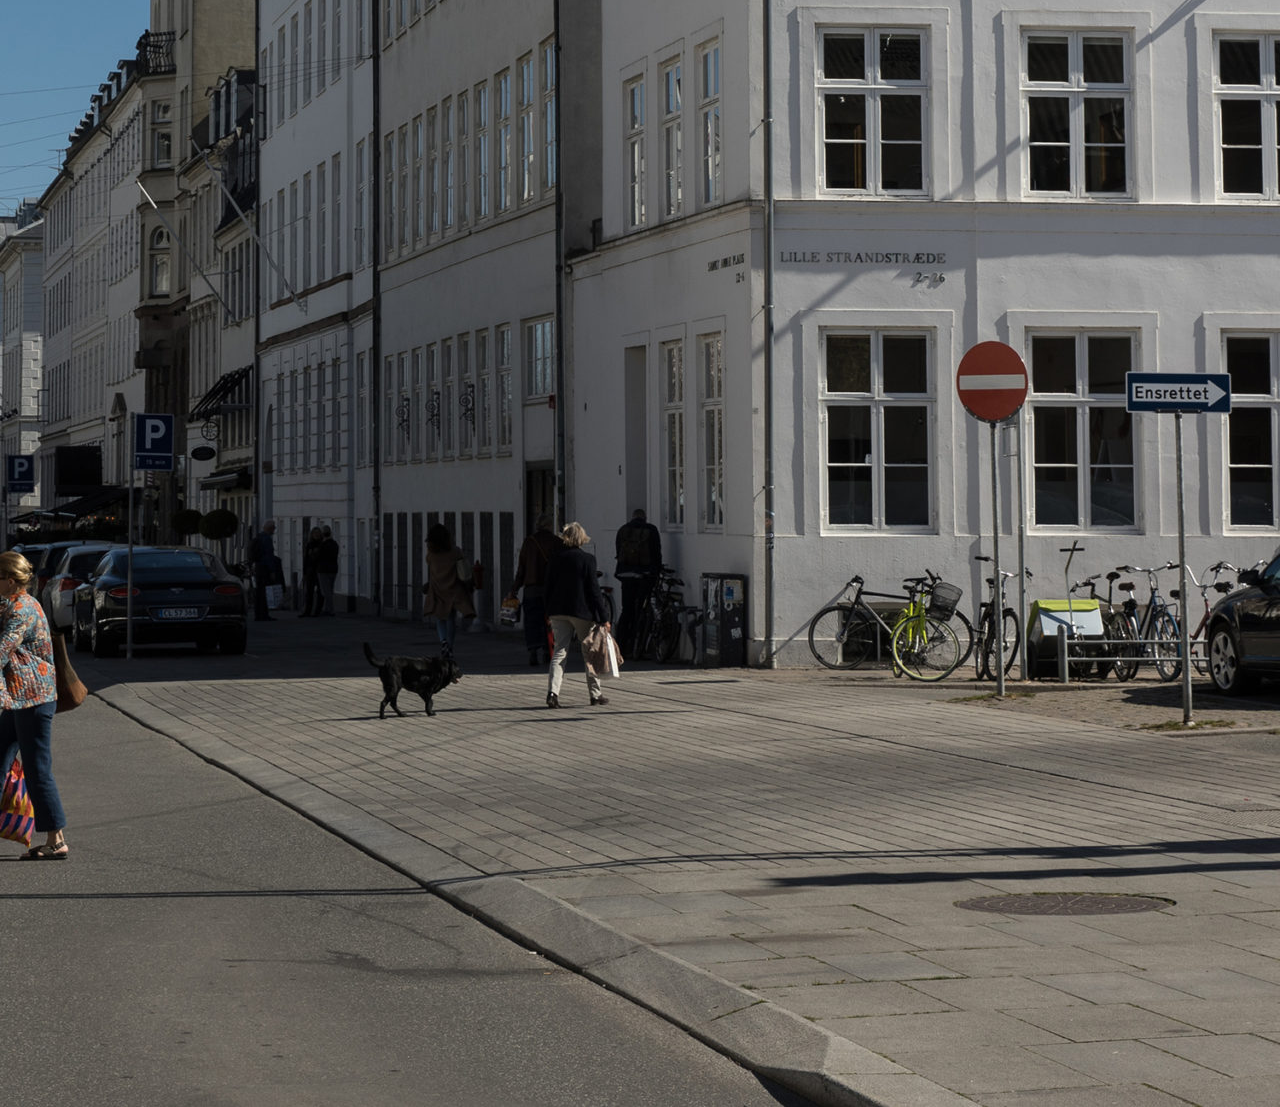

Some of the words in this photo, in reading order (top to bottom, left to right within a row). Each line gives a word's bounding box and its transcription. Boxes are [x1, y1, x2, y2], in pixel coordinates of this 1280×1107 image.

[779, 251, 821, 263] LILLE
[826, 252, 947, 264] STRANDSTRÆDE
[1135, 385, 1209, 400] Ensrettet
[145, 419, 166, 449] P
[14, 458, 29, 479] P
